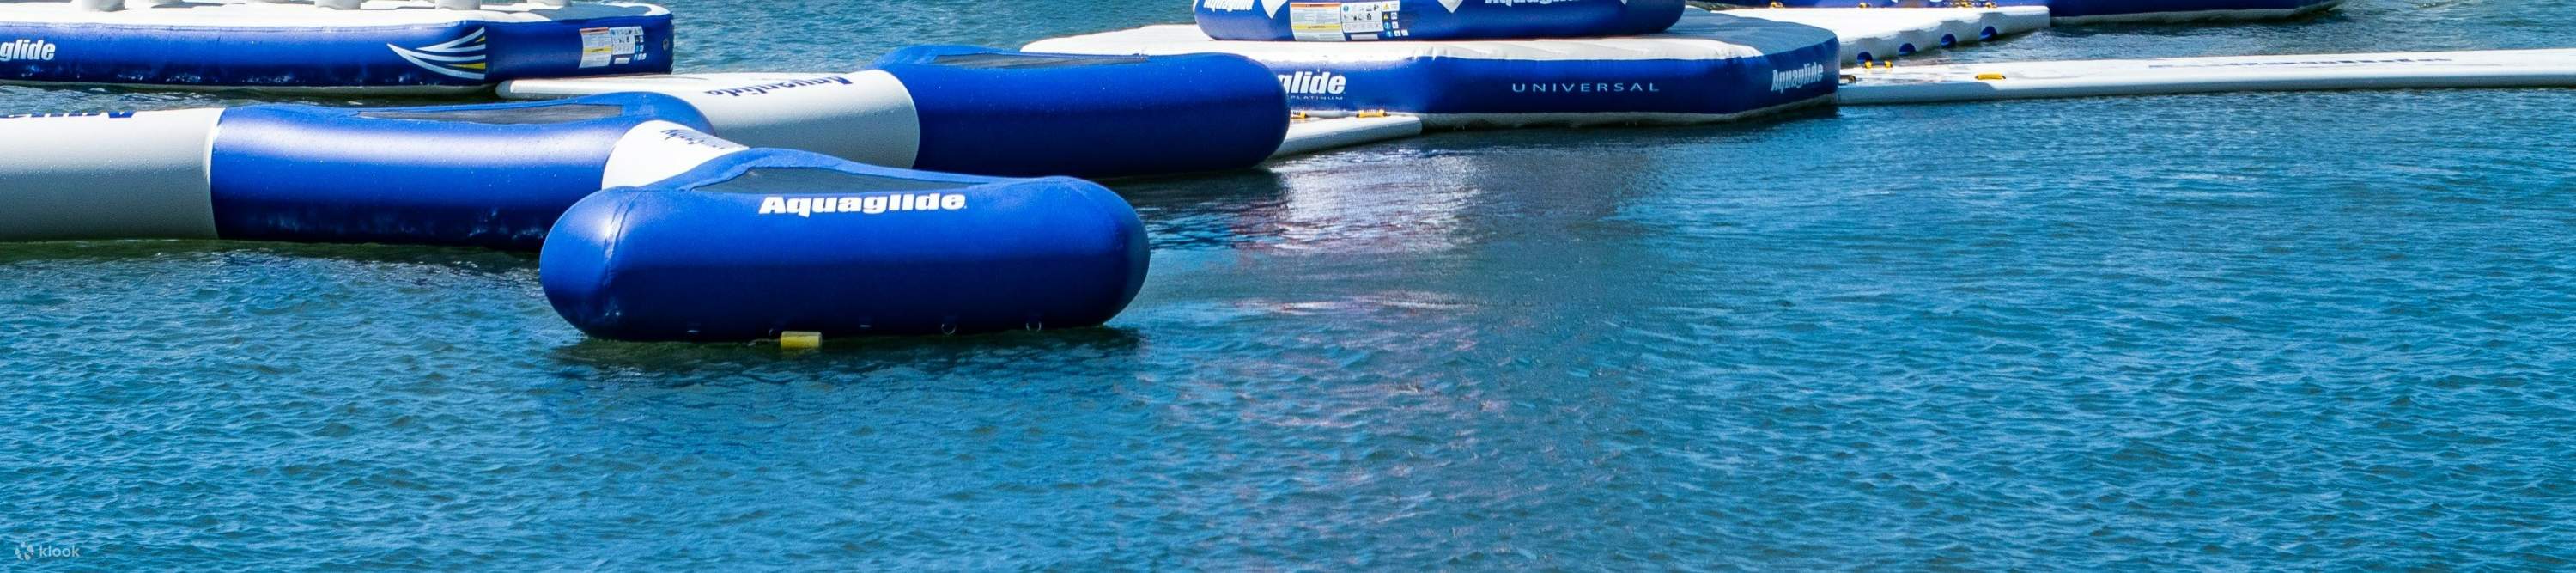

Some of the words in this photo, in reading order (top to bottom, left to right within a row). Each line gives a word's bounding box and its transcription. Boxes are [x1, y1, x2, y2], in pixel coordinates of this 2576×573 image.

[0, 39, 56, 61] glide
[1511, 82, 1660, 93] UNIVERSAL
[1771, 62, 1824, 94] Aquaglide
[758, 193, 966, 218] Aquaglide
